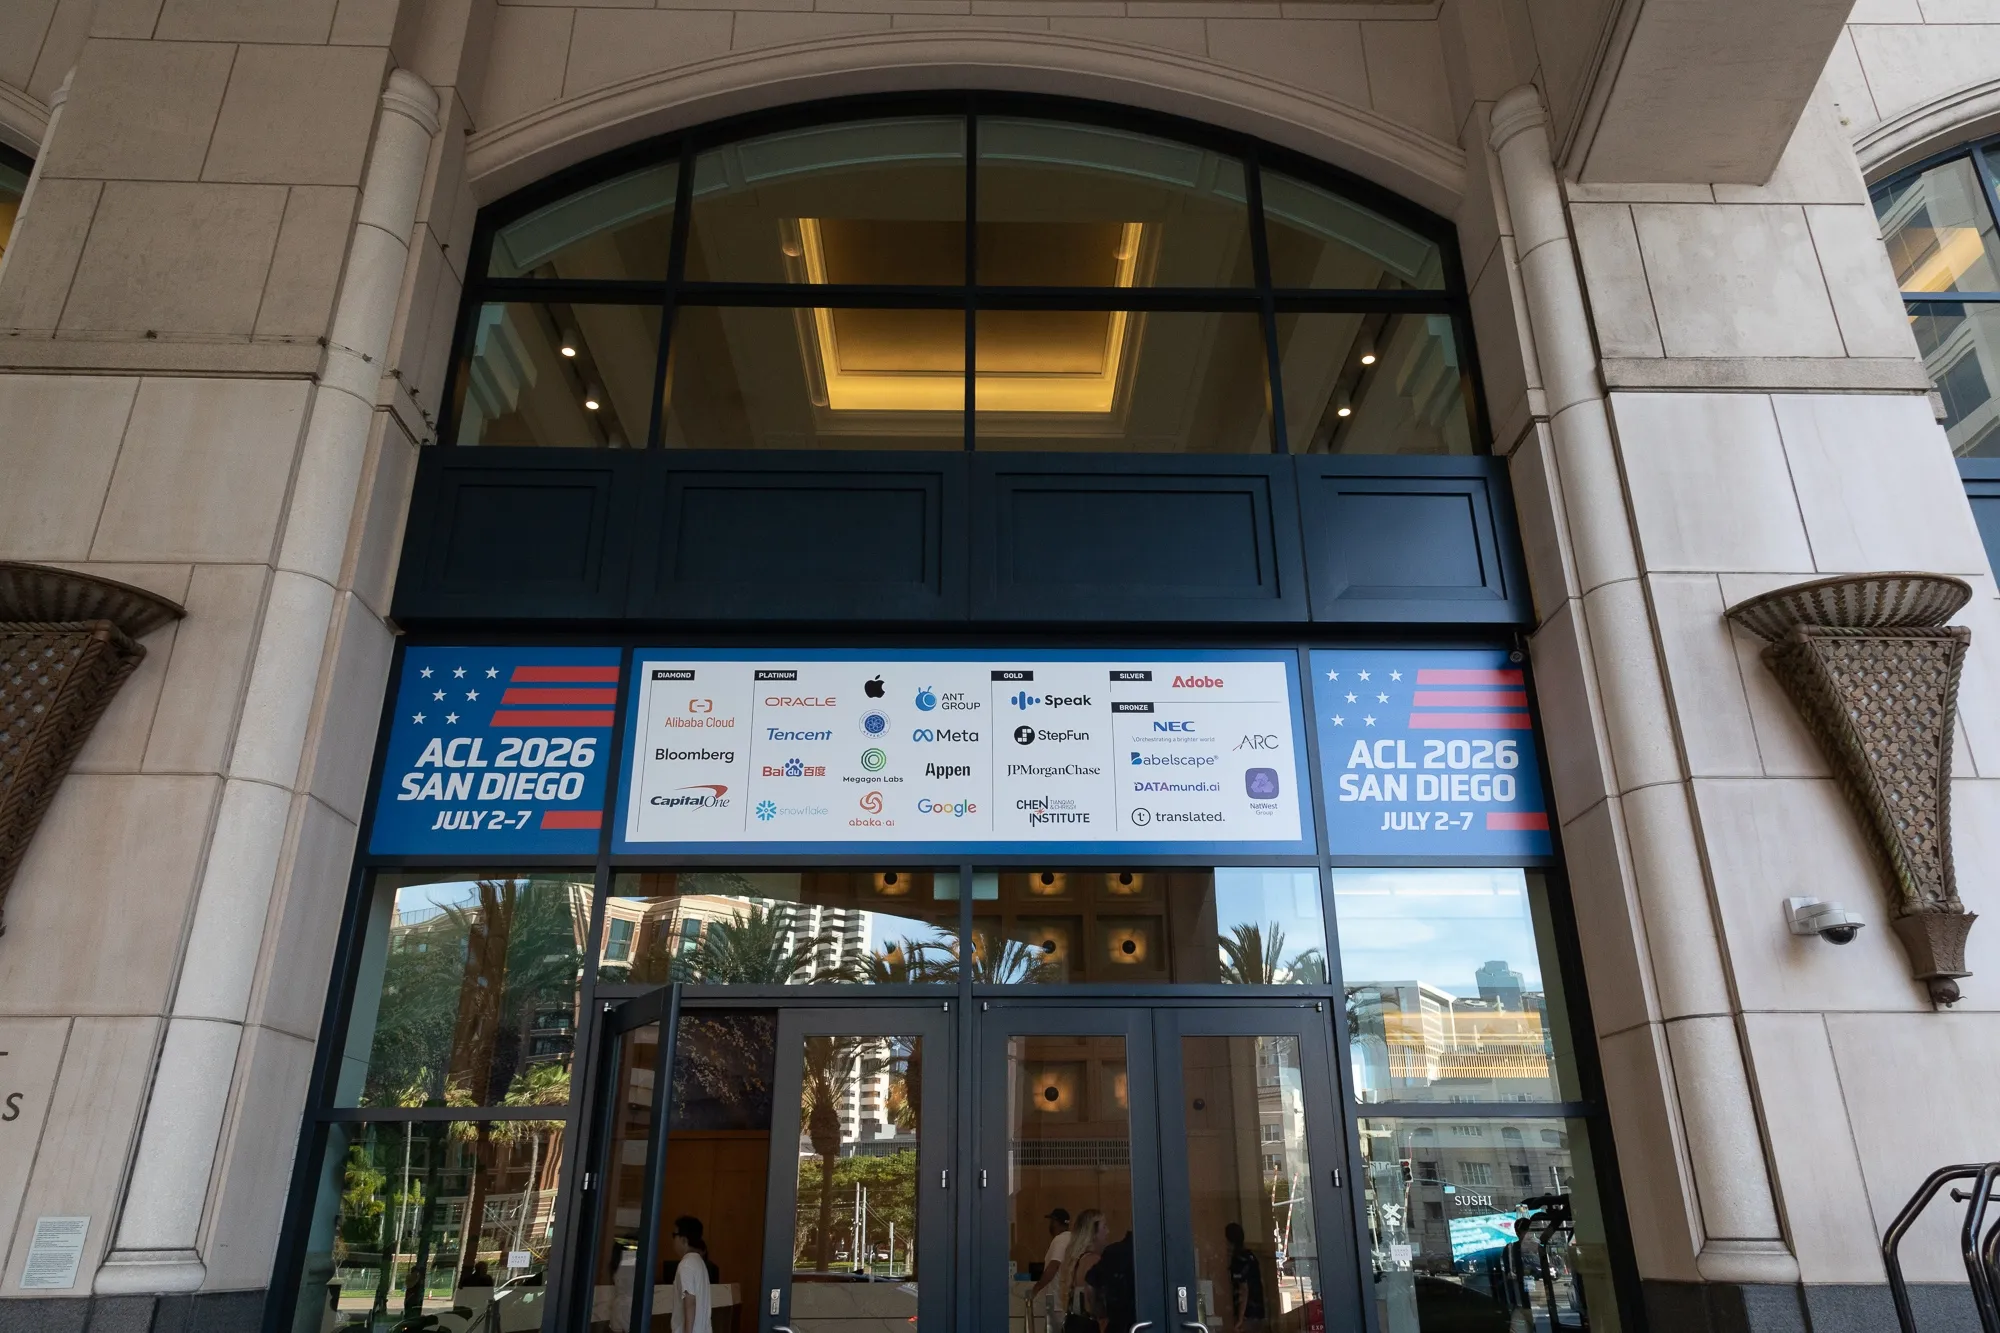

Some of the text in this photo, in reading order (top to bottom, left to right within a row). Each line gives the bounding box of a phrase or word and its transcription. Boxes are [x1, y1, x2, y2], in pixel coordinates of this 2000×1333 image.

[1172, 675, 1224, 688] Adobe
[765, 697, 836, 706] ORACLE
[942, 693, 965, 701] ANT
[1044, 695, 1092, 708] Speak
[941, 702, 980, 710] GROUP
[665, 717, 735, 728] Alibaba Cloud
[1153, 721, 1195, 732] NEC
[767, 728, 833, 740] Tencent
[936, 729, 979, 742] Meta
[1038, 730, 1090, 742] StepFun
[1240, 735, 1279, 750] ARC
[414, 738, 597, 767] ACL 2026
[655, 748, 734, 763] Bloomberg
[1347, 740, 1519, 769] ACL 2026
[925, 763, 971, 779] Appen
[1007, 764, 1101, 777] JPMorganChase
[397, 773, 585, 800] SAN DIEGO
[1134, 782, 1220, 791] DATAmundi.ai
[1339, 774, 1516, 801] SAN DIEGO
[918, 799, 977, 817] Google
[1016, 795, 1048, 810] CHEN
[780, 806, 828, 816] snowflake
[432, 811, 488, 830] JULY
[1029, 813, 1090, 827] INSTITUTE
[1381, 812, 1431, 830] JULY
[1454, 1195, 1493, 1206] SUSHI
